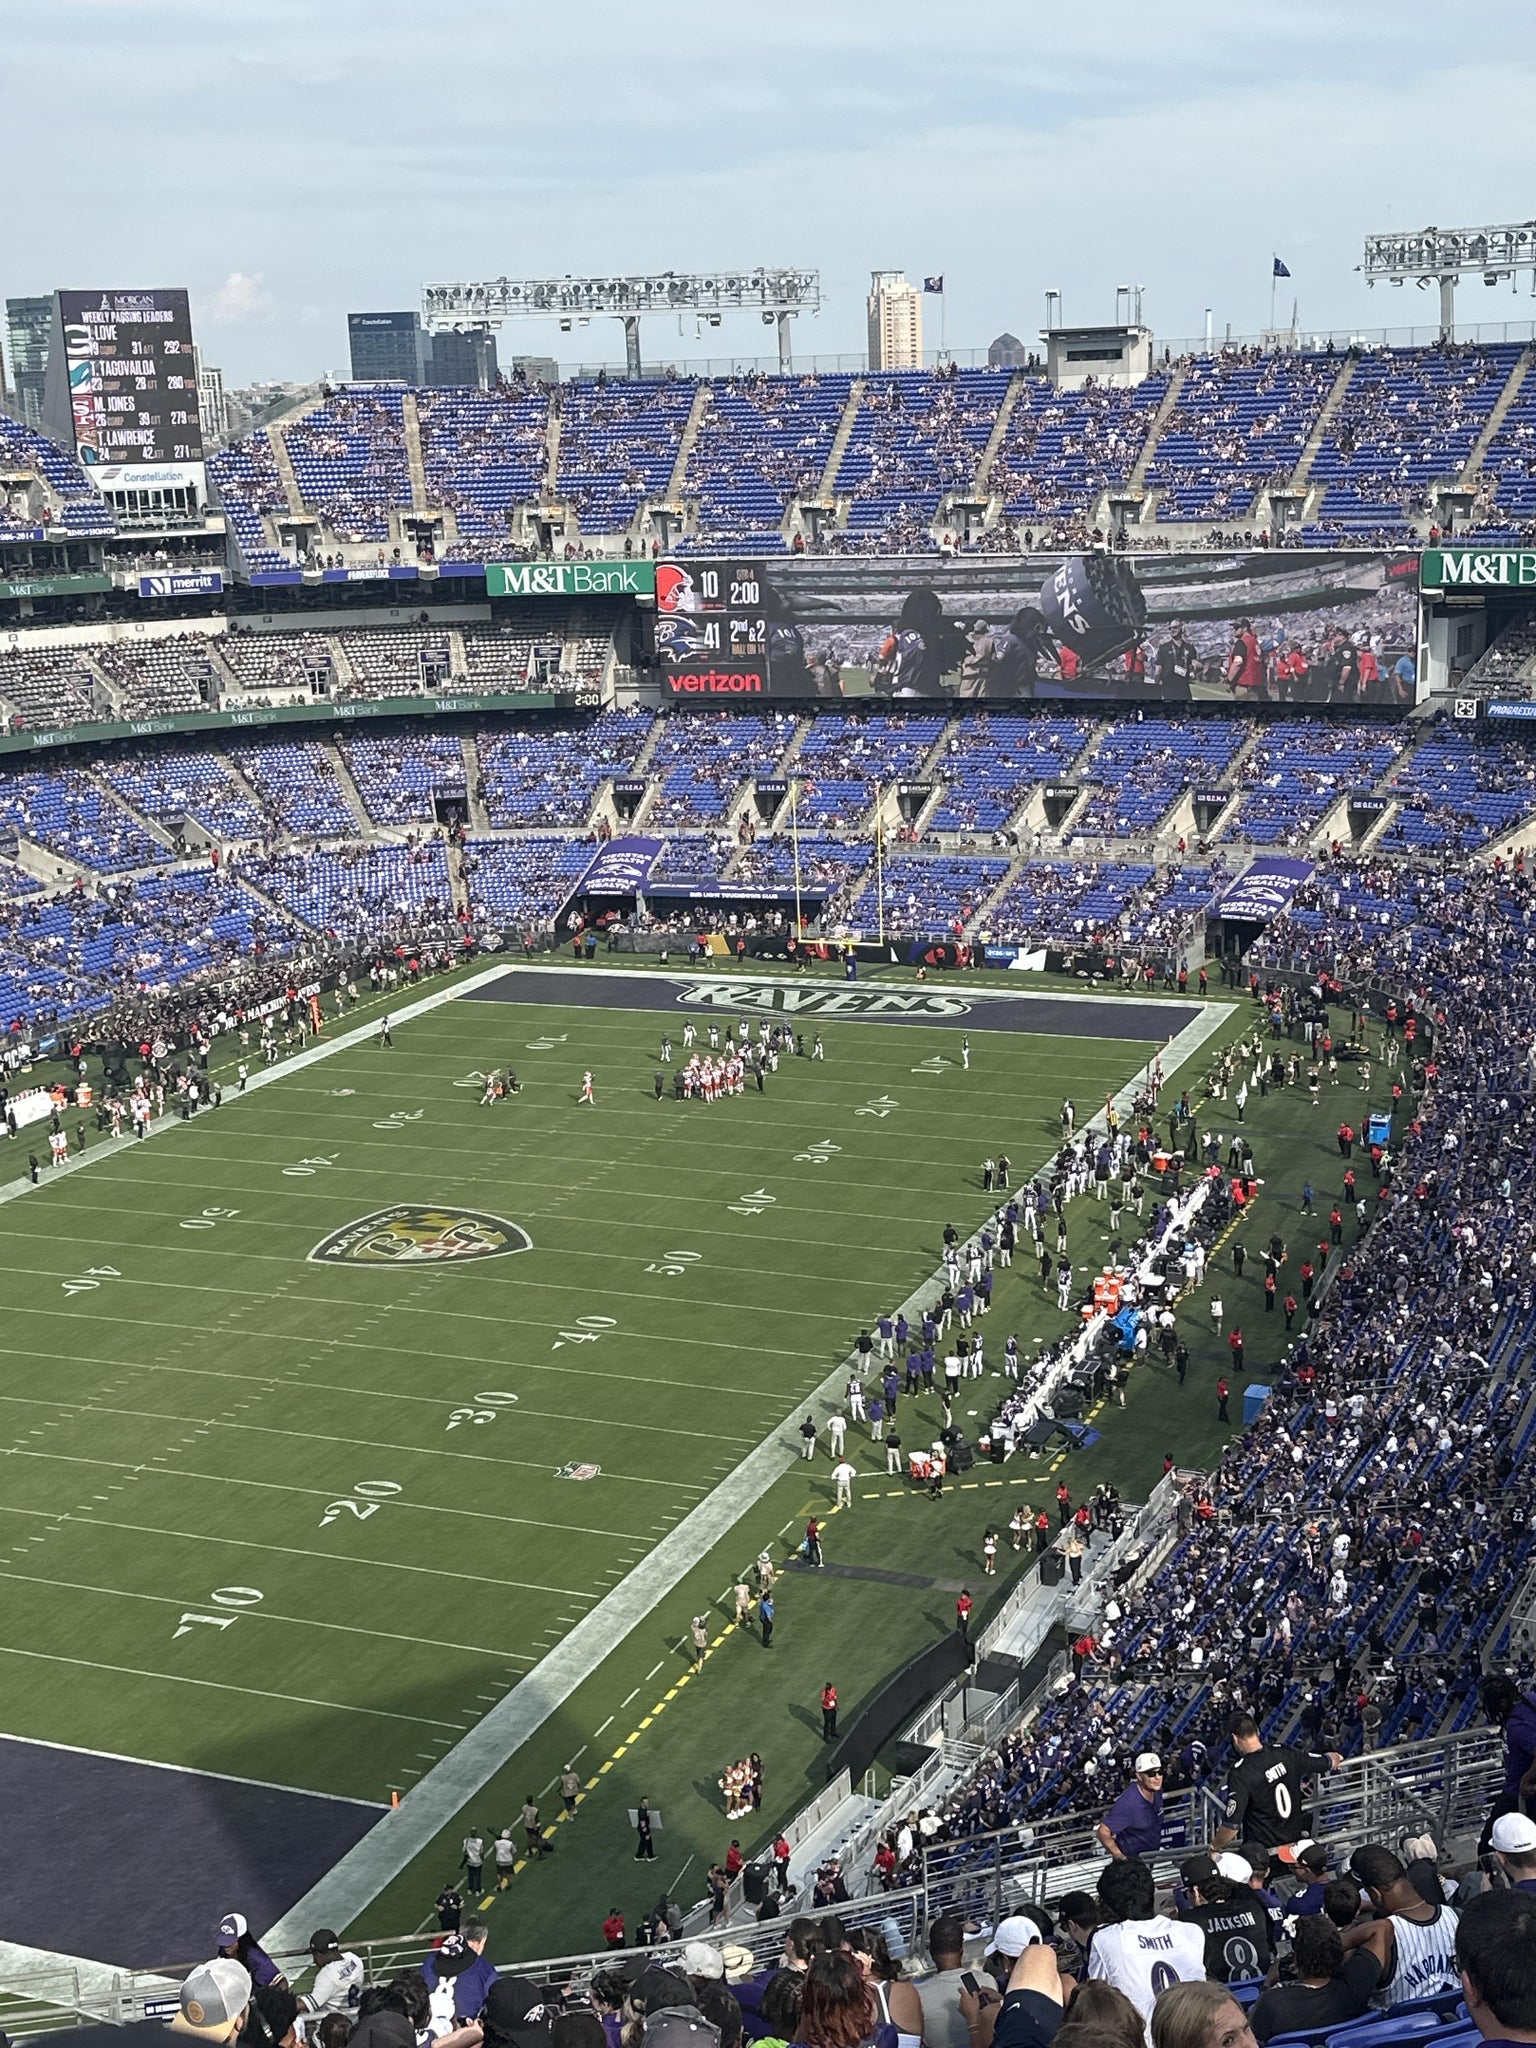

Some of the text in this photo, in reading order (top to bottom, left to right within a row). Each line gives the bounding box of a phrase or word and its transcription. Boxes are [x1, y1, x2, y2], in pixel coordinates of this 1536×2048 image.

[114, 295, 155, 305] MORGAN
[81, 310, 174, 323] WEEKLY PASSING LEADERS
[95, 325, 118, 340] LOVE
[132, 341, 143, 354] 31
[164, 341, 180, 354] 292
[100, 360, 156, 376] TAGOVAILOA
[91, 378, 103, 391] 23
[94, 396, 135, 412] M. JONES
[95, 413, 107, 427] 26
[139, 412, 150, 425] 39
[171, 411, 187, 425] 279
[107, 430, 155, 446] LAWRENCE
[99, 447, 110, 460] 24
[142, 446, 154, 459] 42
[174, 445, 190, 458] 271
[124, 472, 183, 482] Constellation
[1440, 553, 1517, 584] M&T
[173, 576, 212, 588] merritt
[501, 566, 639, 594] M&T Bank
[700, 571, 718, 598] 10
[9, 584, 55, 597] M&T Bank
[730, 582, 760, 604] 2:00
[704, 622, 720, 649] 41
[730, 619, 748, 642] 2nd
[668, 669, 762, 692] verizon
[435, 701, 458, 711] M&T
[574, 694, 599, 707] 2:00
[334, 705, 357, 716] M&T
[1457, 703, 1474, 717] 25
[231, 714, 254, 725] M&T
[131, 722, 152, 734] M&T
[33, 733, 55, 745] M&T
[600, 853, 652, 861] MEDSTAR
[584, 878, 638, 886] MEDSTAR
[1242, 875, 1300, 885] MEDSTAR
[1243, 880, 1291, 889] HEALTH
[1219, 902, 1277, 913] MEDSTAR
[1219, 907, 1268, 916] HEALTH
[684, 982, 966, 1014] RAVENS
[854, 1099, 900, 1118] 20
[372, 1110, 424, 1129] 30
[792, 1143, 843, 1164] 30
[282, 1155, 332, 1176] 40
[727, 1193, 777, 1216] 40
[179, 1207, 241, 1229] 50
[325, 1210, 410, 1256] RAVENS
[644, 1250, 703, 1276] 50
[62, 1265, 122, 1290] 40
[558, 1315, 617, 1344] 40
[449, 1391, 519, 1425] 30
[324, 1480, 402, 1521] 20
[180, 1586, 264, 1631] 10
[1265, 1762, 1288, 1784] SMITH
[1275, 1782, 1292, 1819] 0
[1207, 1911, 1256, 1934] JACKSON
[1137, 1934, 1174, 1950] SMITH
[1223, 1936, 1264, 1983] 8
